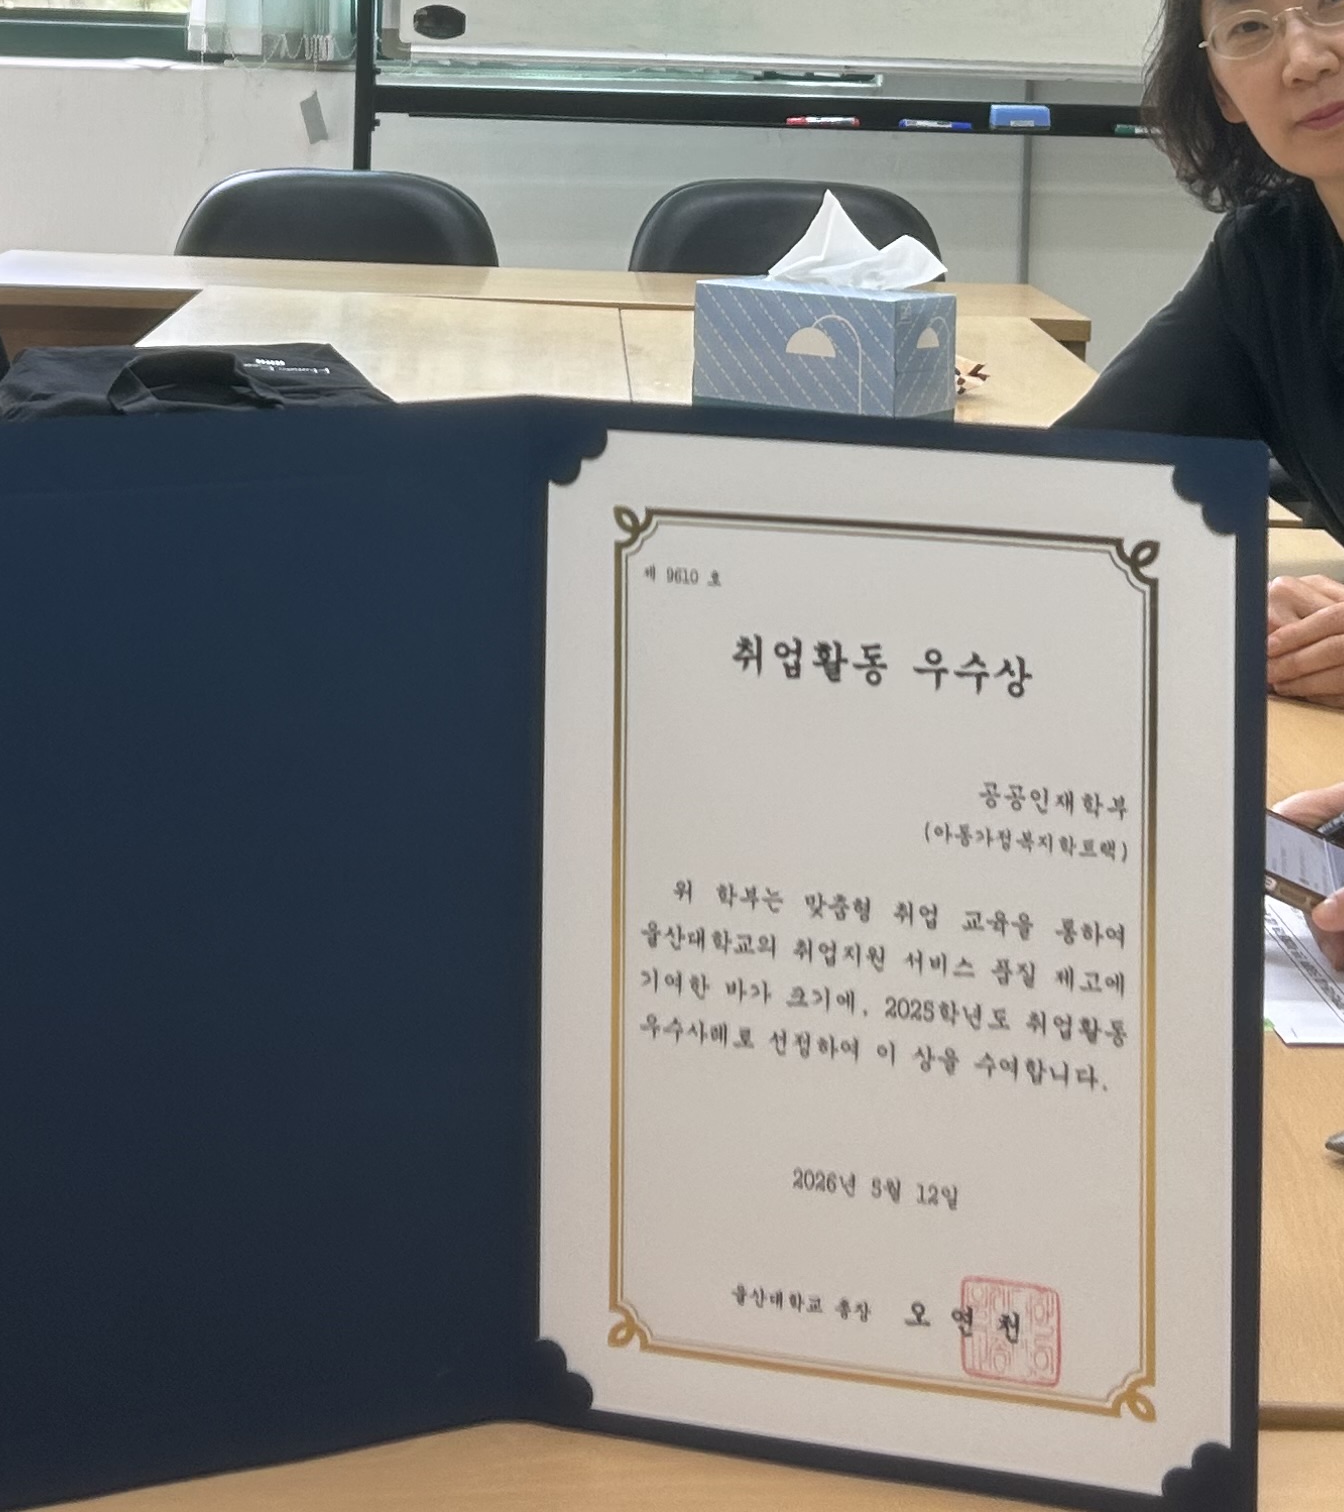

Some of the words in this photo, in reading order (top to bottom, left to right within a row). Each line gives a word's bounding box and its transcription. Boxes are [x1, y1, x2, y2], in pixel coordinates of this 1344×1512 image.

[666, 567, 699, 585] 9610
[707, 569, 721, 587] 호
[731, 633, 889, 688] 취업활동
[912, 647, 1033, 698] 우수상
[979, 781, 1128, 821] 공공인재학부
[924, 821, 1128, 863] (아동가정복지학트랙)
[673, 879, 693, 905] 위
[716, 882, 784, 914] 학부는
[804, 891, 871, 924] 맞춤형
[893, 900, 938, 931] 취업
[961, 909, 1034, 942] 교육을
[1055, 918, 1126, 950] 통하여
[640, 920, 777, 960] 울산대학교의
[793, 937, 886, 973] 취업지원
[905, 948, 975, 978] 서비스
[991, 958, 1036, 989] 품질
[1055, 965, 1125, 998] 제고에
[641, 967, 710, 1001] 기여한
[725, 977, 772, 1005] 바가
[884, 995, 1011, 1031] 2025학년도
[1025, 1010, 1128, 1049] 취업활동
[639, 1013, 755, 1049] 우수사례로
[769, 1028, 860, 1062] 선정하여
[876, 1040, 896, 1067] 이
[914, 1045, 960, 1076] 상을
[974, 1051, 1108, 1092] 수여합니다.
[792, 1168, 856, 1198] 2026년
[871, 1178, 902, 1204] 5월
[916, 1183, 958, 1211] 12일
[731, 1284, 823, 1314] 울산대학교
[835, 1297, 872, 1323] 총장
